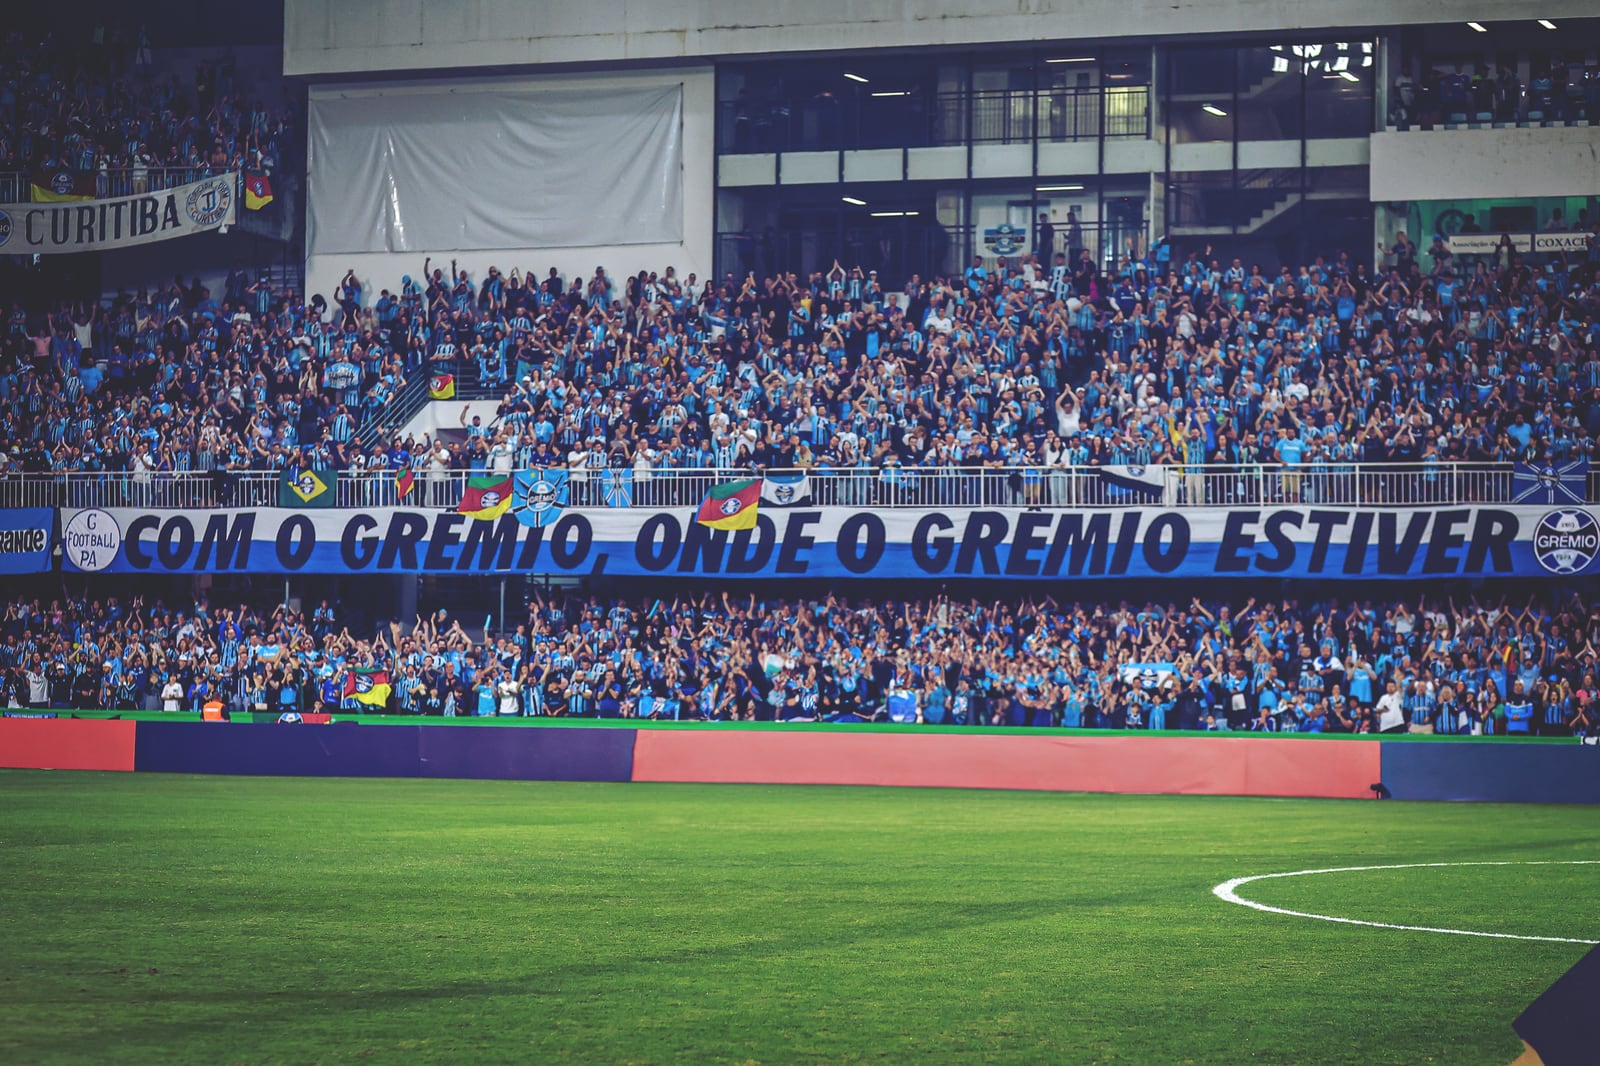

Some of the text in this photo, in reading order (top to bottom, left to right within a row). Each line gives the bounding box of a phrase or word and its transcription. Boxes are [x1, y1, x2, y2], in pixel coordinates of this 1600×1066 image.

[25, 194, 181, 246] CURITIBA
[87, 513, 97, 530] G
[67, 531, 116, 549] FOOTBALL
[124, 512, 256, 570] COM
[275, 514, 316, 570] O
[634, 512, 822, 574] ONDE
[836, 512, 886, 574] O
[1214, 509, 1520, 575] ESTIVER
[79, 550, 97, 567] PA
